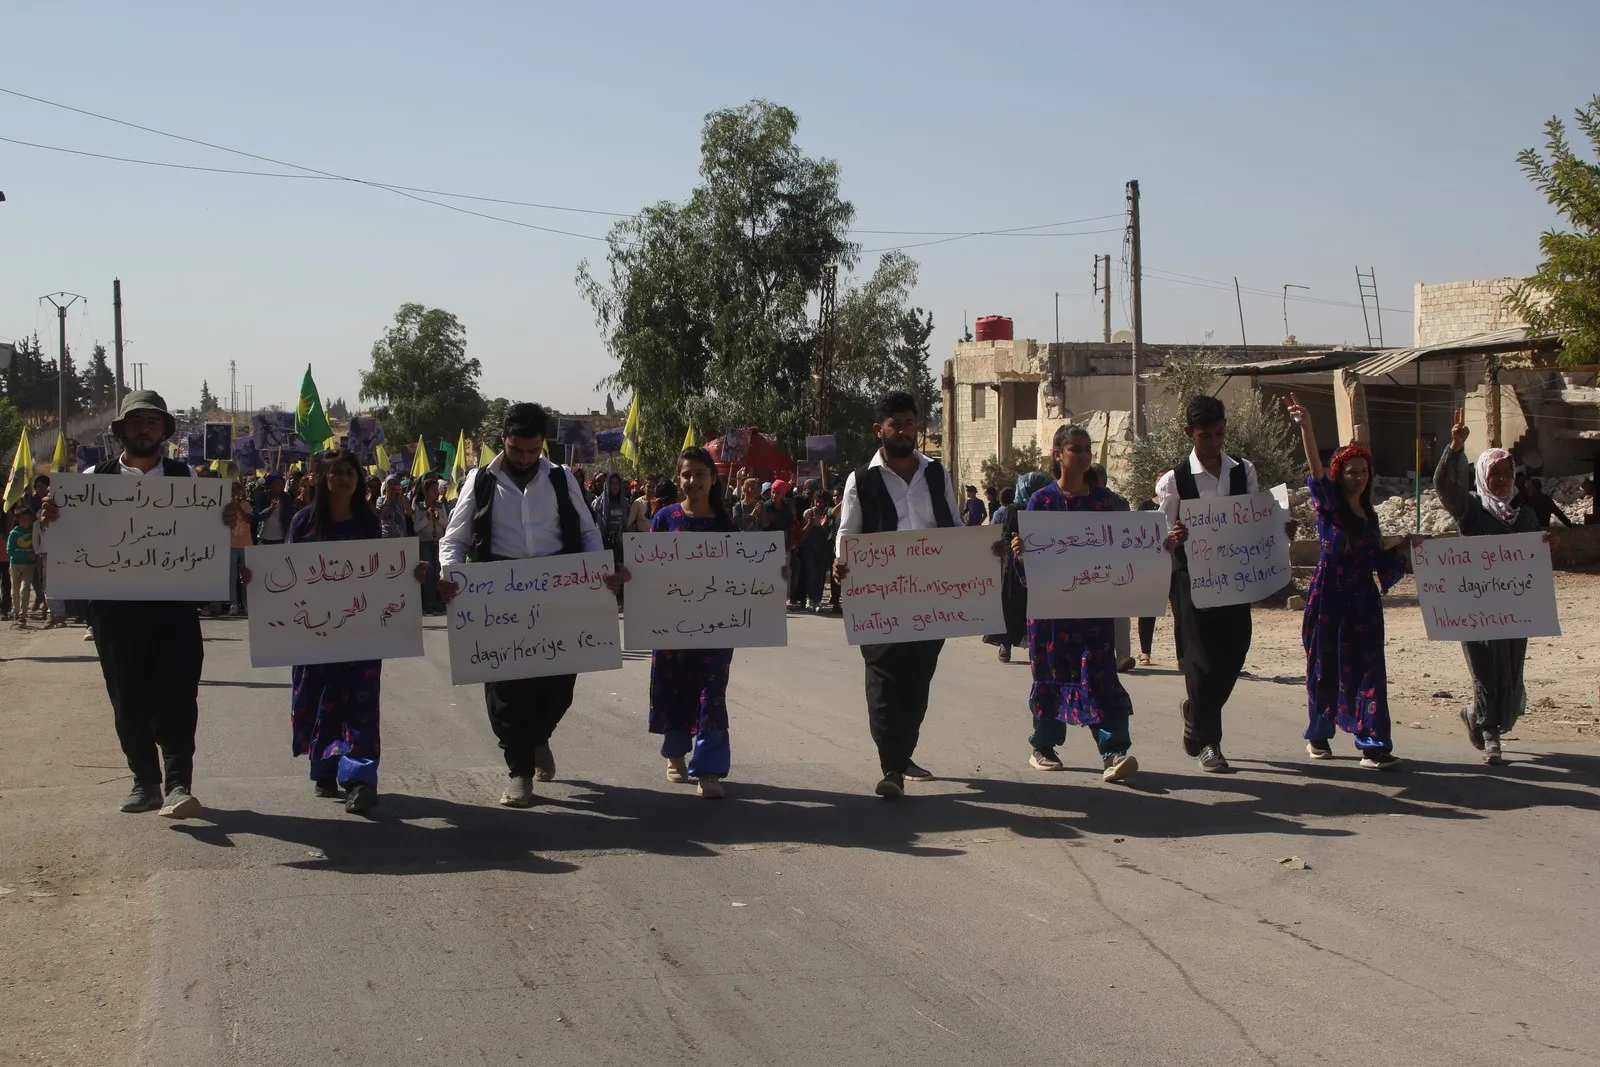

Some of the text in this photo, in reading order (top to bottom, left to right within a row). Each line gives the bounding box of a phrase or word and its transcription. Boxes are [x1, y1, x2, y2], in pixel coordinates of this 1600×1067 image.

[1184, 504, 1228, 532] Azadiya
[907, 538, 944, 556] netew
[484, 604, 520, 628] bese
[527, 604, 541, 630] ji
